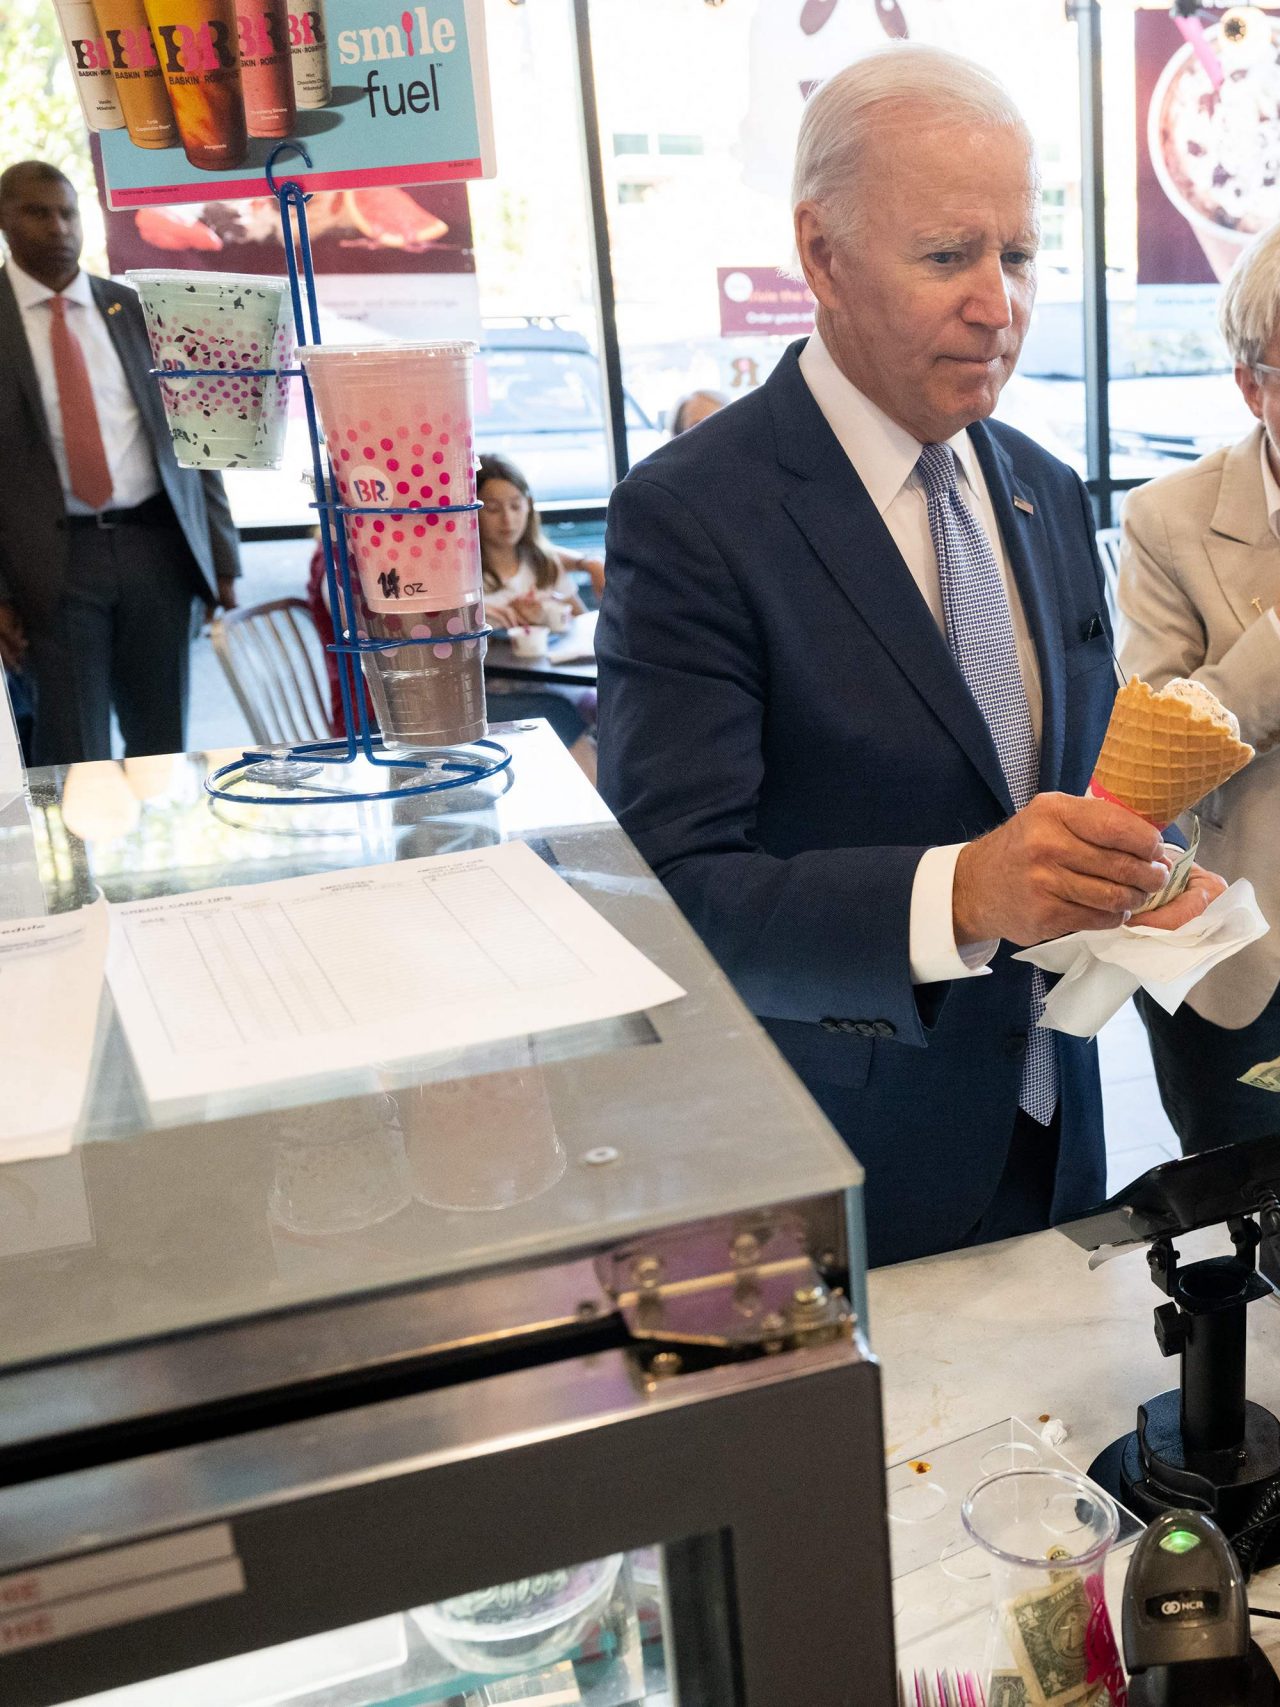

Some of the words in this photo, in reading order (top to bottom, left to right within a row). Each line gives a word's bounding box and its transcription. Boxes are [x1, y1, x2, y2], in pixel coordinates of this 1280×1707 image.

[158, 20, 237, 73] BR
[115, 71, 141, 80] BASKIN
[169, 76, 199, 85] BASKIN
[353, 479, 386, 502] BR
[1181, 1600, 1204, 1611] NCR
